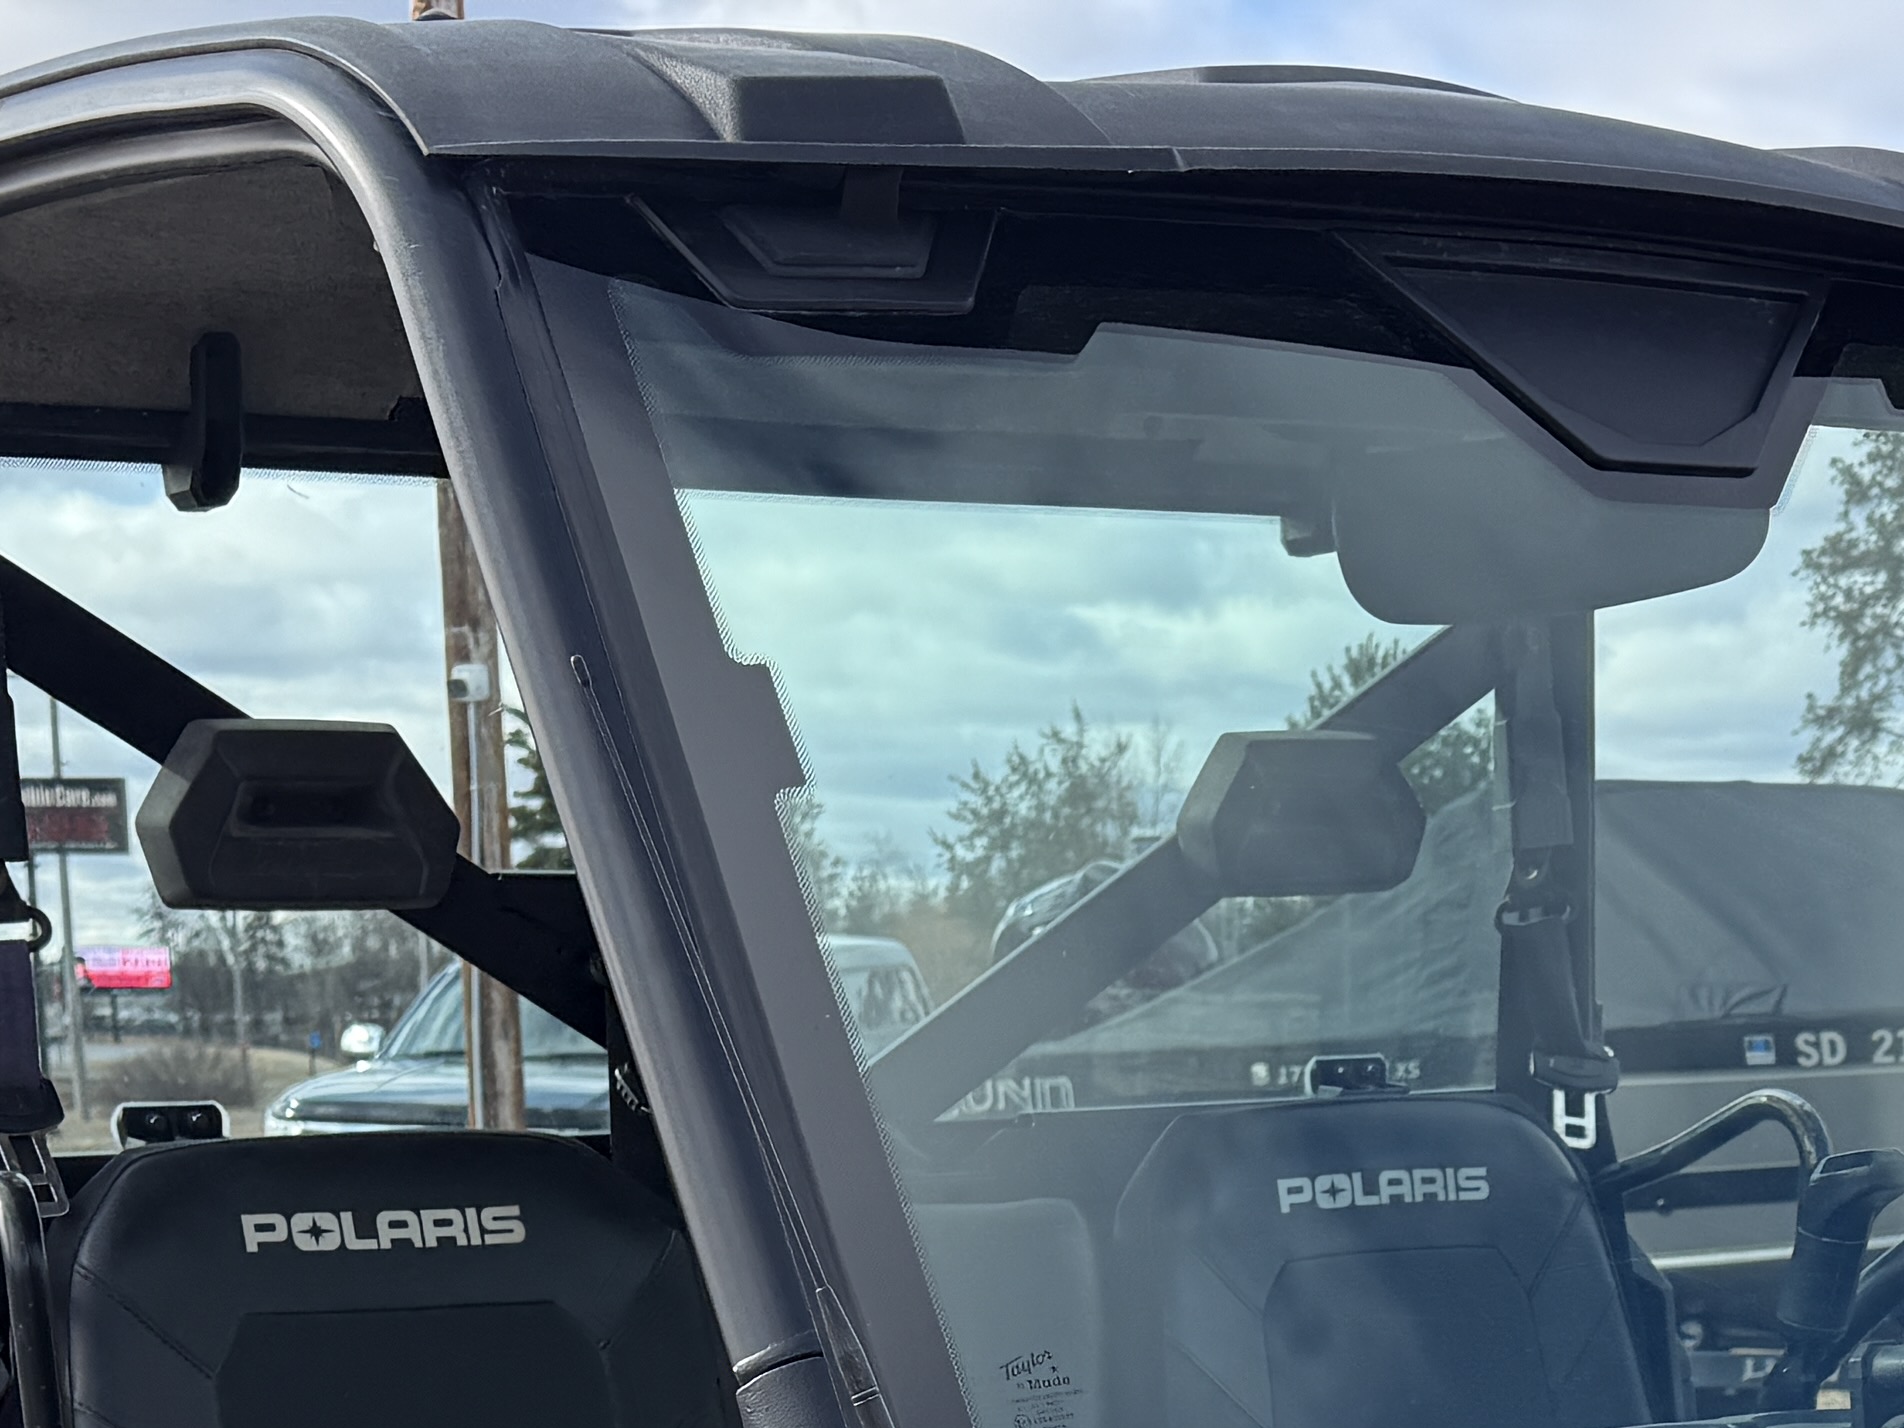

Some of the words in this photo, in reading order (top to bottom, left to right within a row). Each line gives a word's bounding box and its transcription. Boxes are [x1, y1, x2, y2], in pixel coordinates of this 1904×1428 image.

[1795, 1031, 1847, 1067] SD
[1275, 1166, 1491, 1214] POLARIS
[240, 1204, 527, 1254] POLARIS
